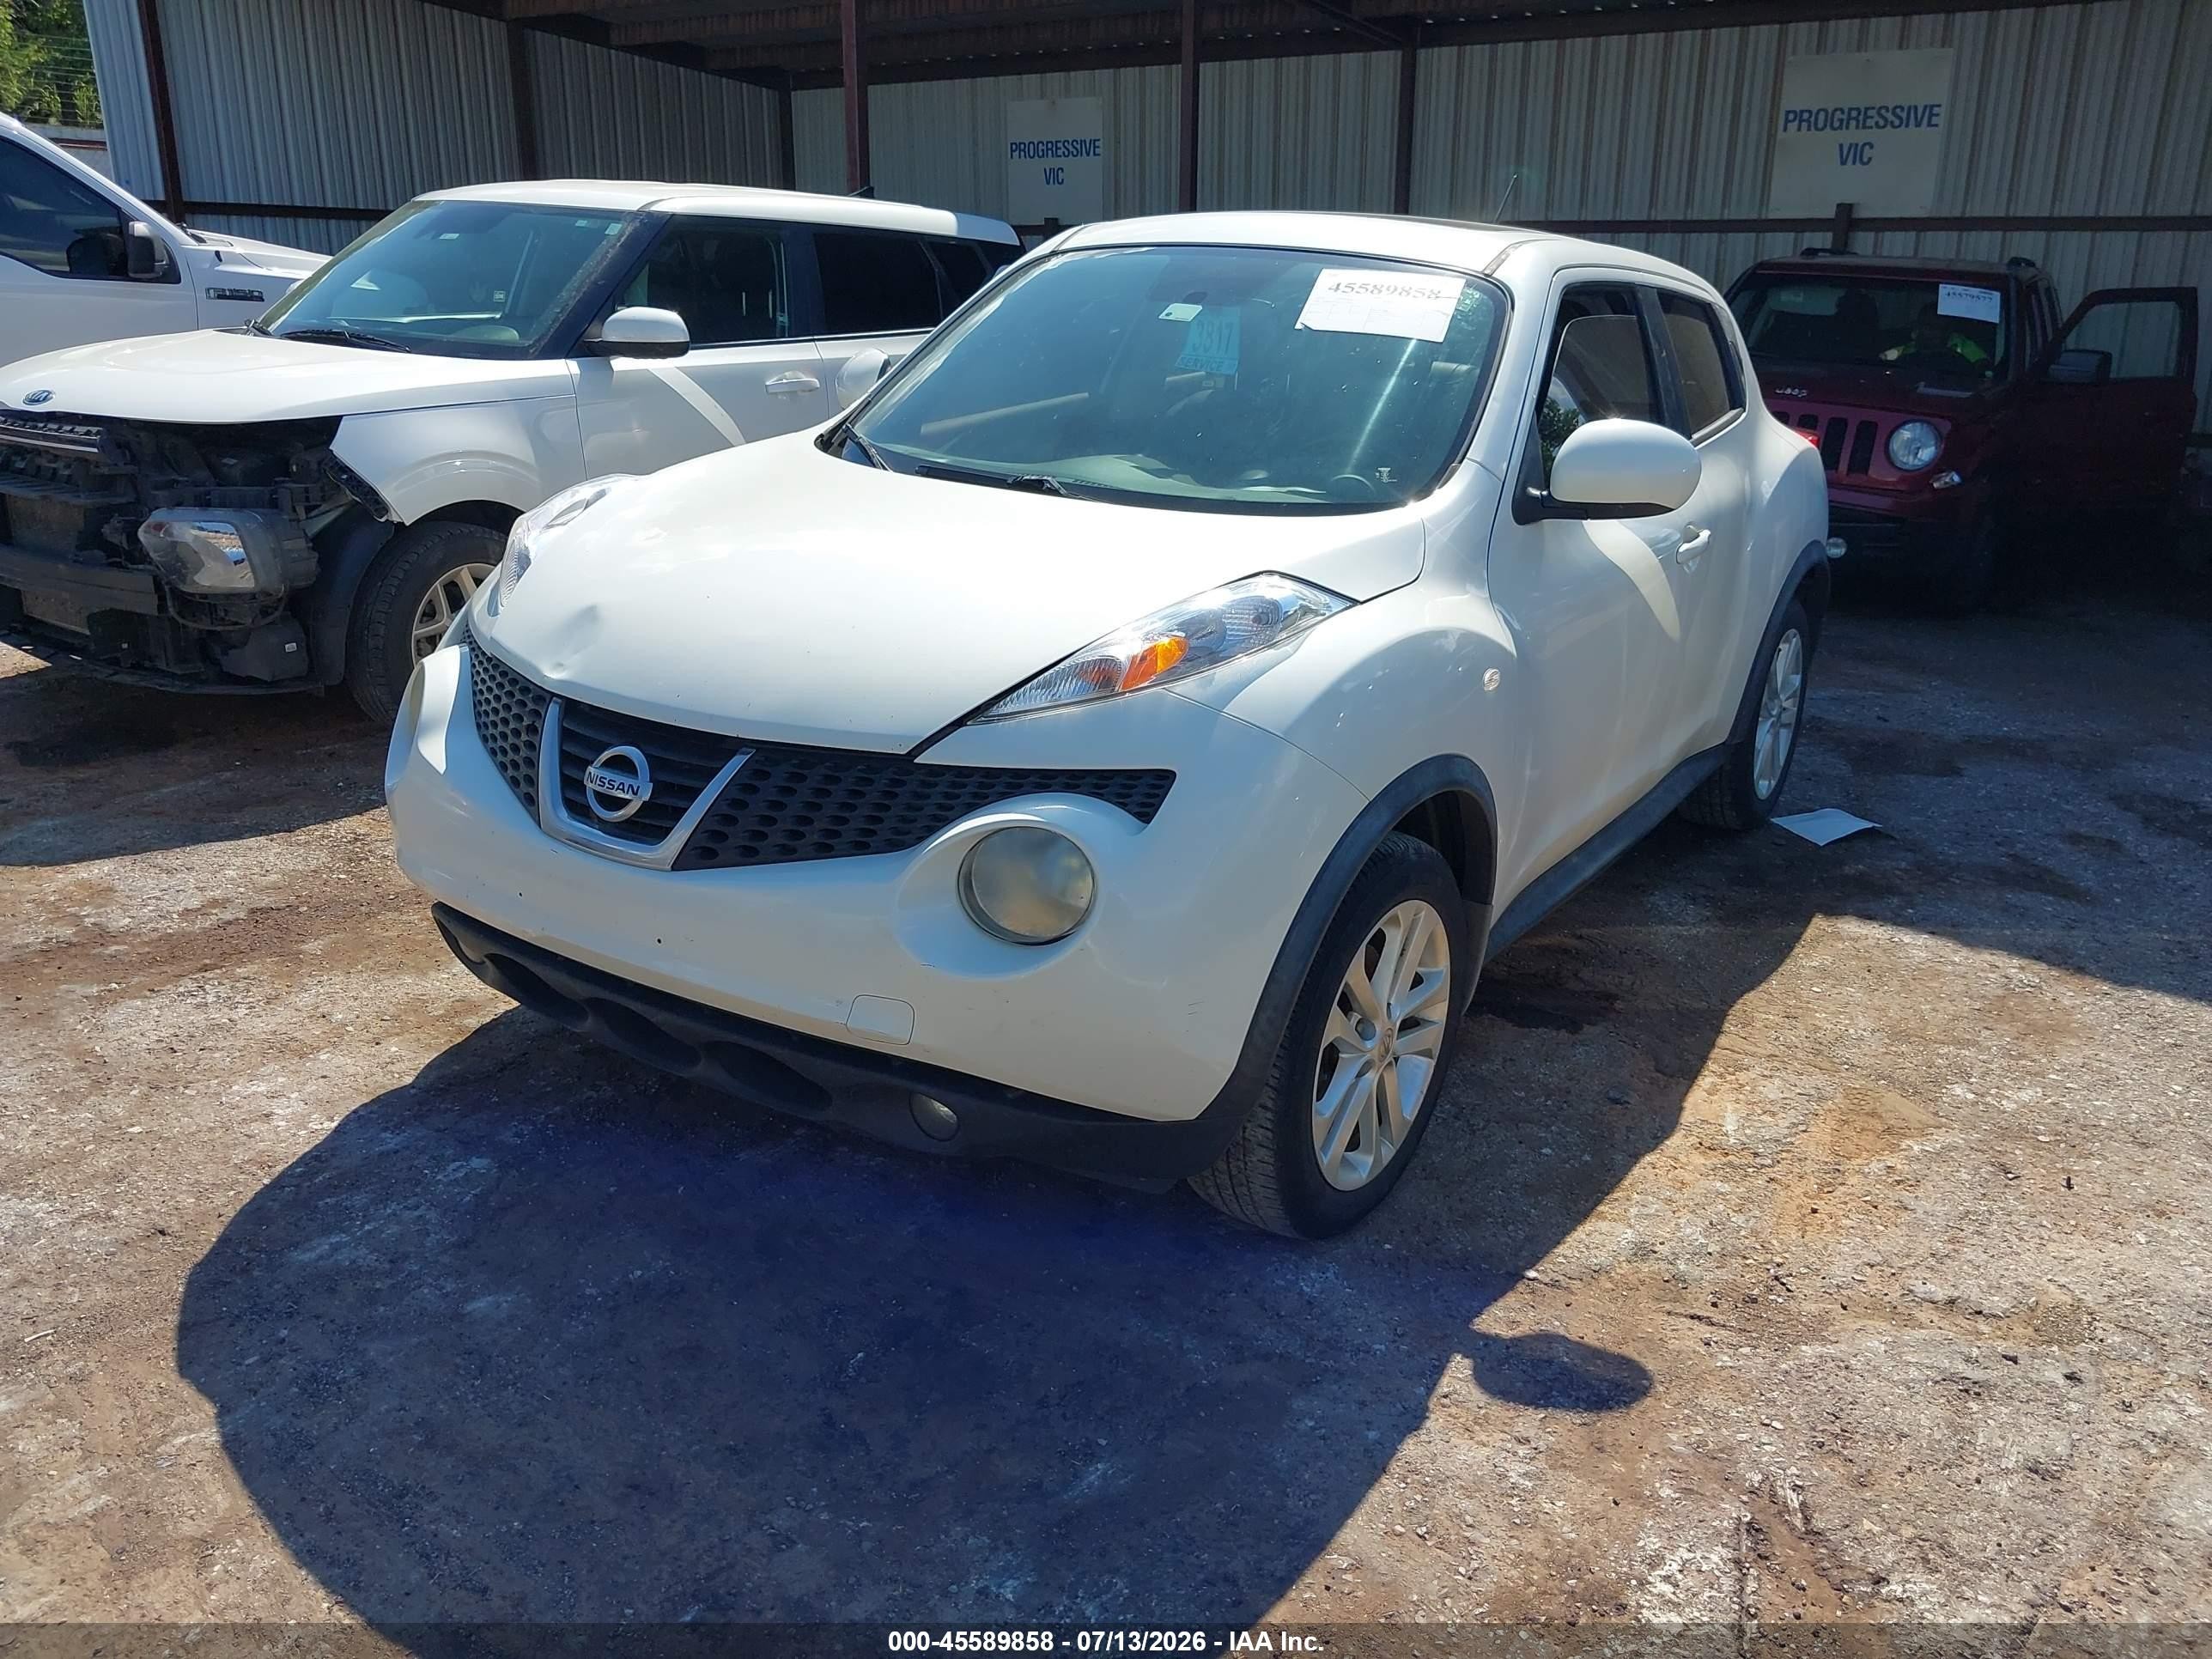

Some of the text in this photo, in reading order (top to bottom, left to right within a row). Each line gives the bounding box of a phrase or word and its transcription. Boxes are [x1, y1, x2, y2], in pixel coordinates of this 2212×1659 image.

[1782, 103, 1942, 132] PROGRESSIVE
[1009, 138, 1101, 160] PROGRESSIVE
[1838, 142, 1875, 166] VIC
[1043, 167, 1065, 185] VIC
[1328, 282, 1442, 301] 45589858
[1177, 356, 1224, 372] SERVICE
[586, 771, 641, 797] NISSAN
